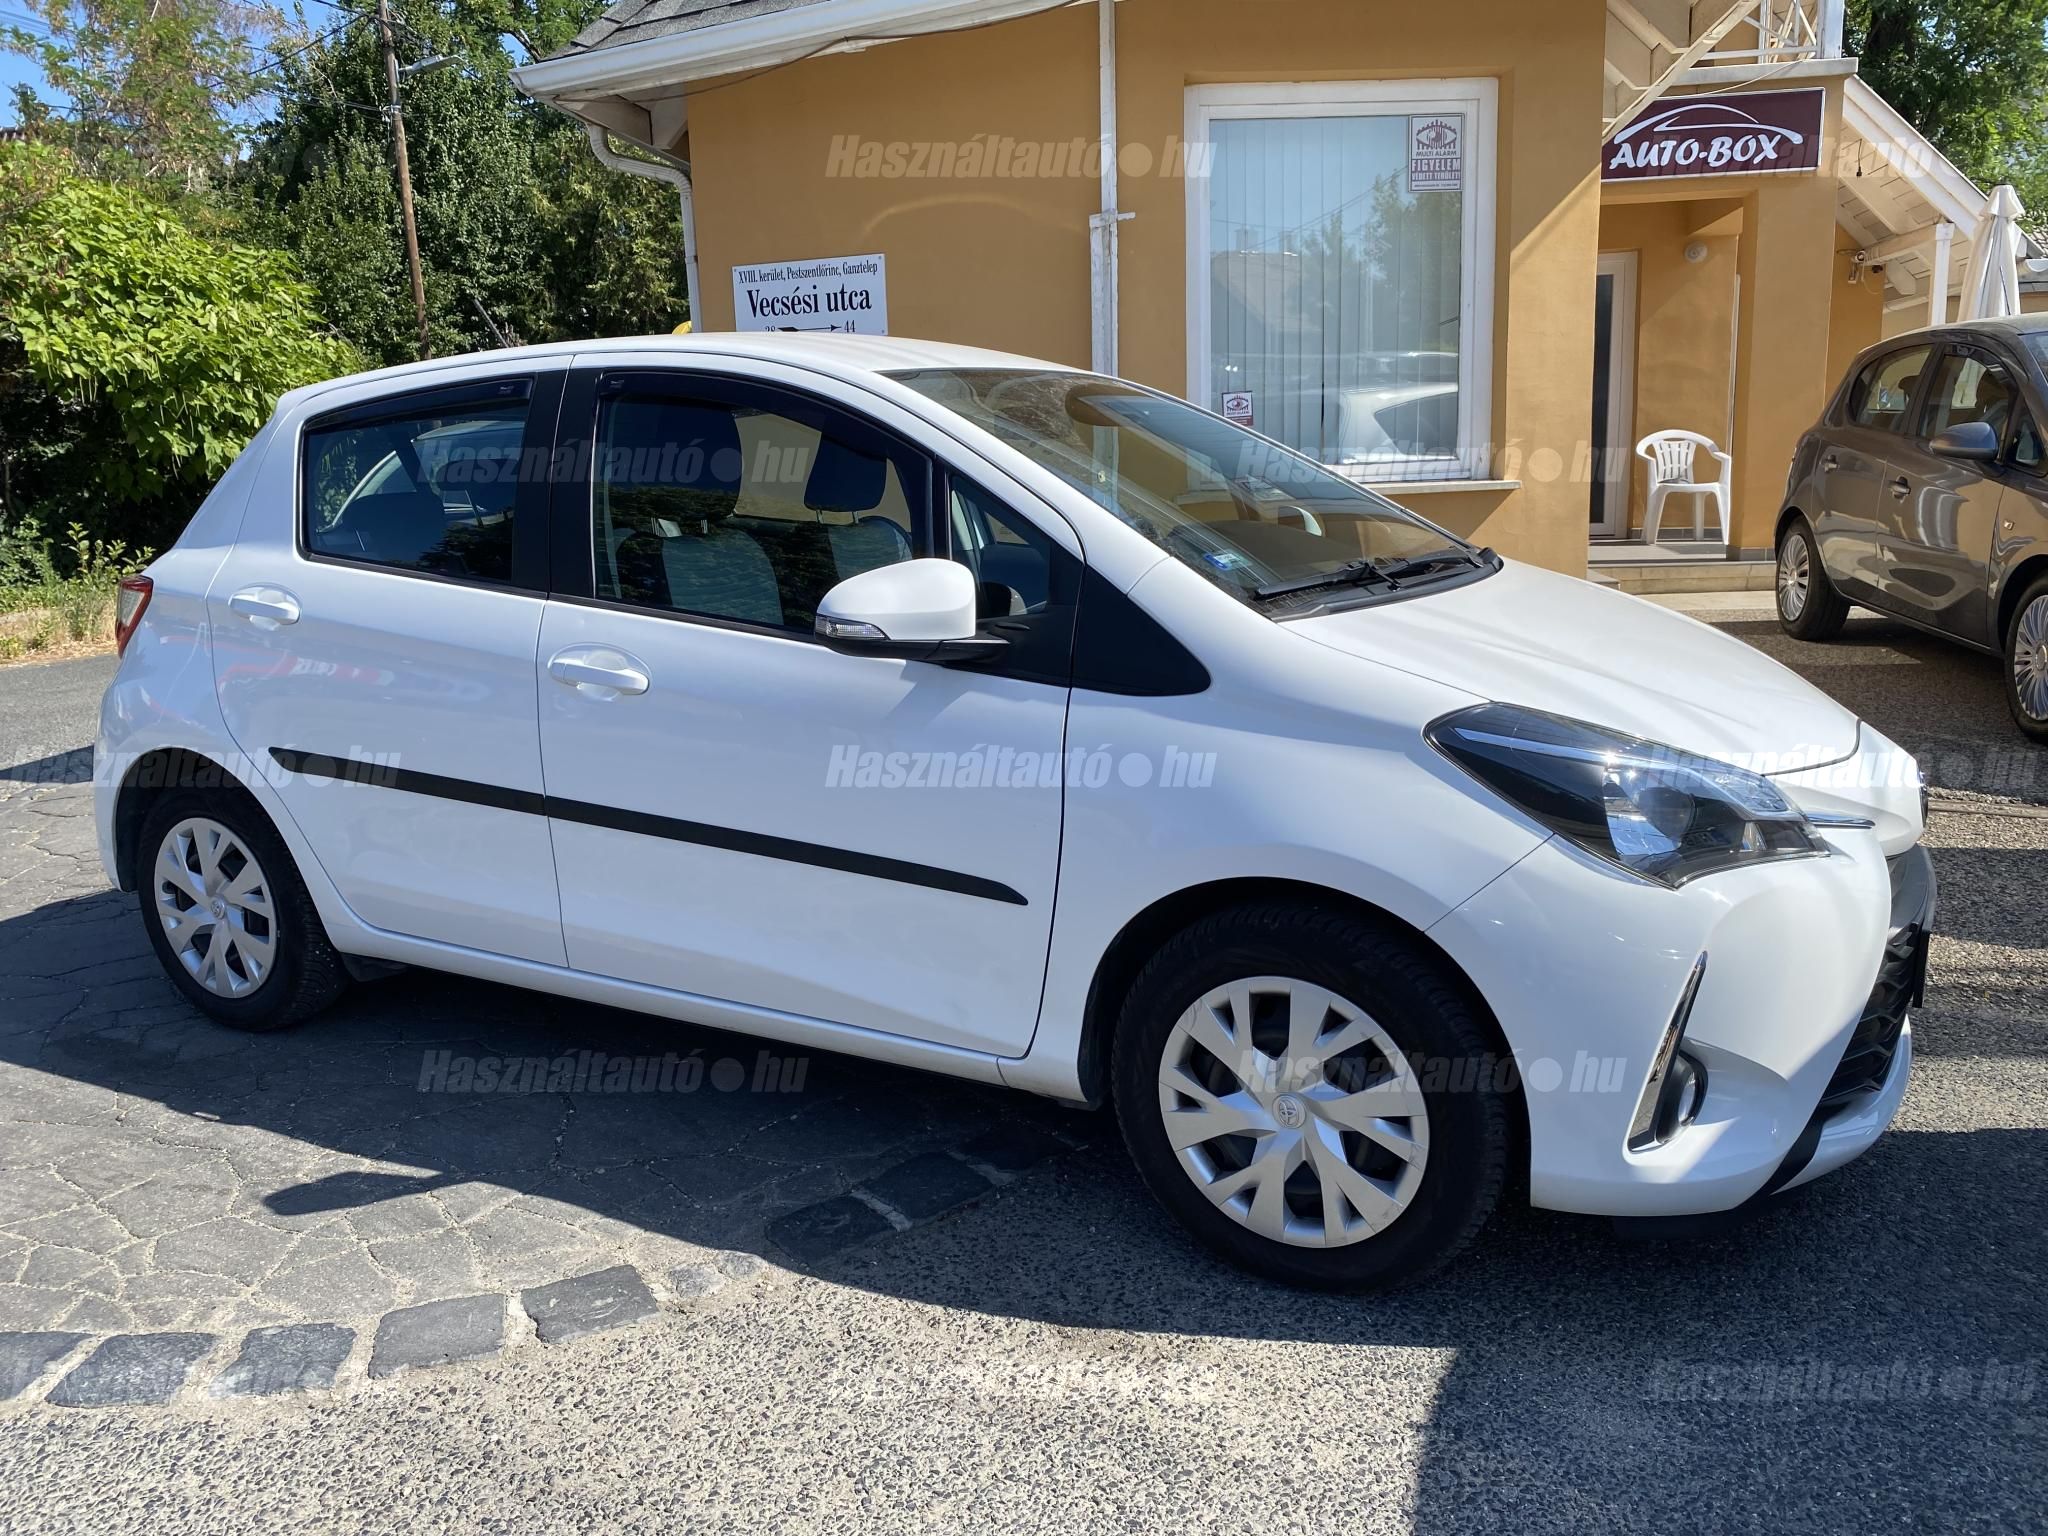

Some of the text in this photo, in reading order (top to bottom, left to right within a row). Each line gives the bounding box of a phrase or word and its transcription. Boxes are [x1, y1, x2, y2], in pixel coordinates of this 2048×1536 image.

[1609, 134, 1782, 170] AUTO-BOX
[1412, 159, 1460, 171] FIGYELEM
[738, 260, 878, 284] XVIII. kerület, Pestszentlőrinc, Ganztelep
[747, 283, 872, 318] Vecsési utca
[844, 320, 856, 333] 44
